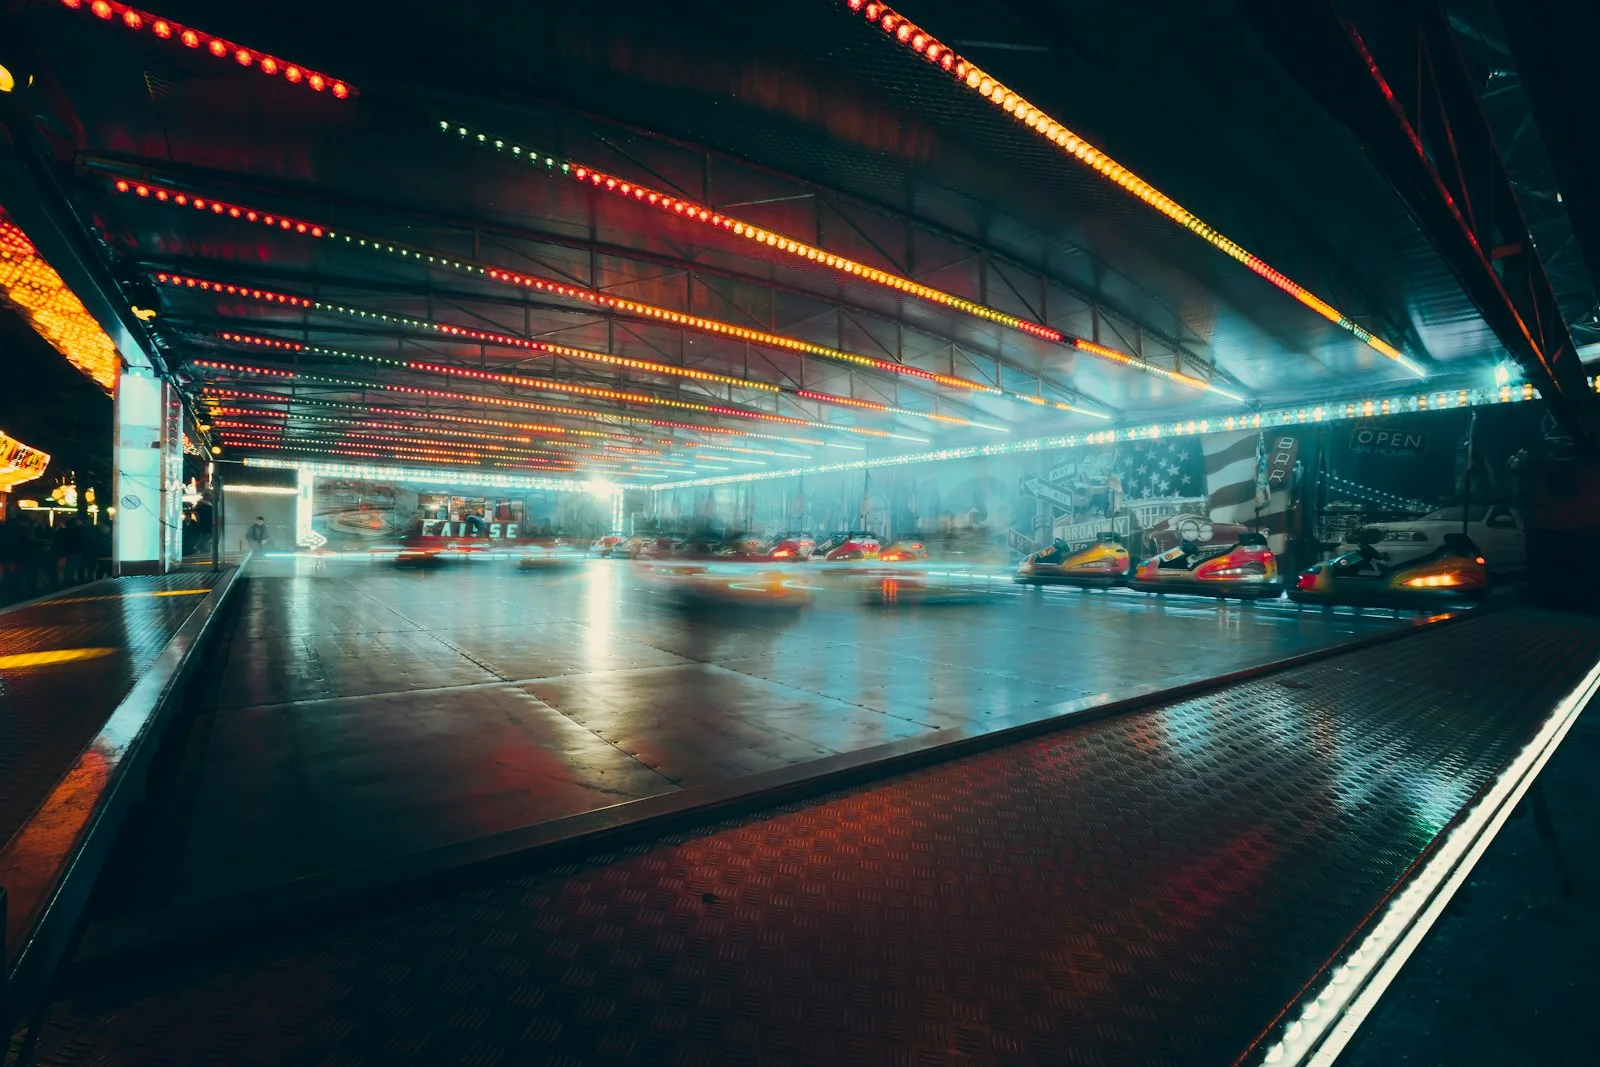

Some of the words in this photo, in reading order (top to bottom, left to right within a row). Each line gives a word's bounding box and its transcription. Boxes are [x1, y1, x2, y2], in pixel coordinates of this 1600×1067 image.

[1358, 430, 1422, 448] OPEN
[1269, 437, 1295, 483] BAR
[1052, 465, 1069, 479] WAY
